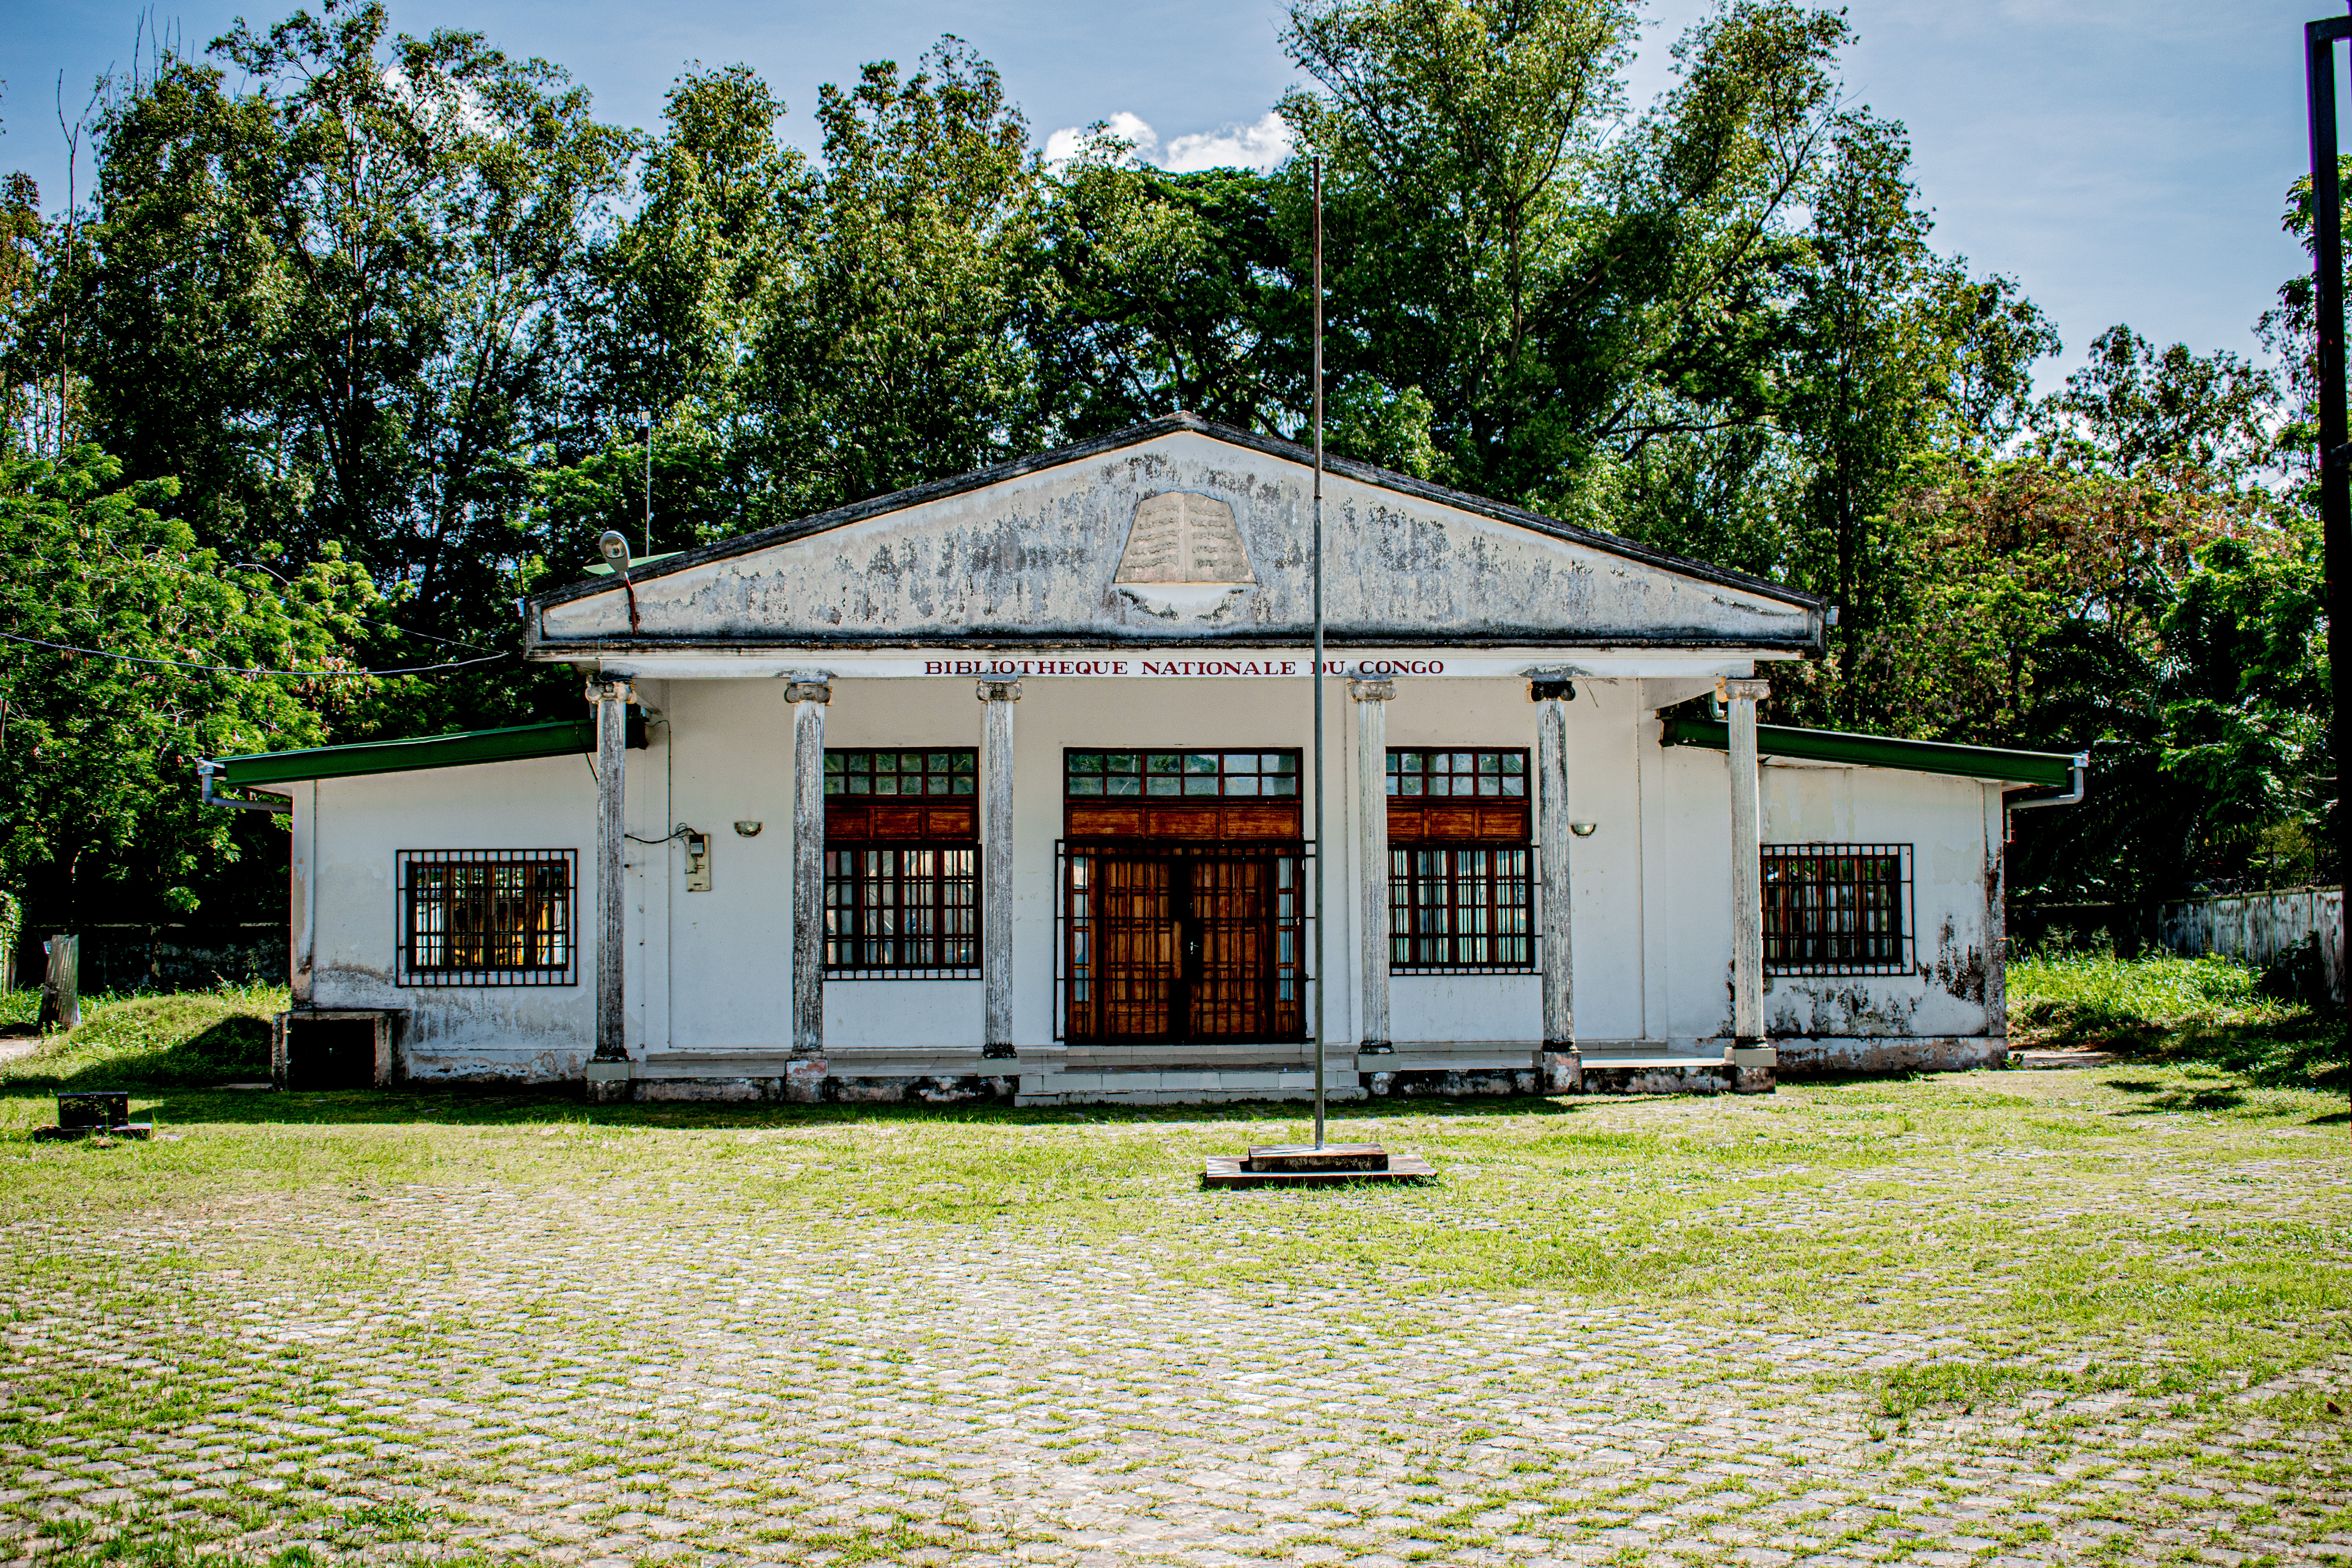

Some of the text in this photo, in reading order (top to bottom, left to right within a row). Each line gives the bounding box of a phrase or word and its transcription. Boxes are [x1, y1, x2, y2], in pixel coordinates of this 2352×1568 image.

[924, 661, 1128, 674] BIBLIOTHEQUE
[1142, 662, 1296, 675] NATIONALE
[1359, 661, 1444, 674] CONGO
